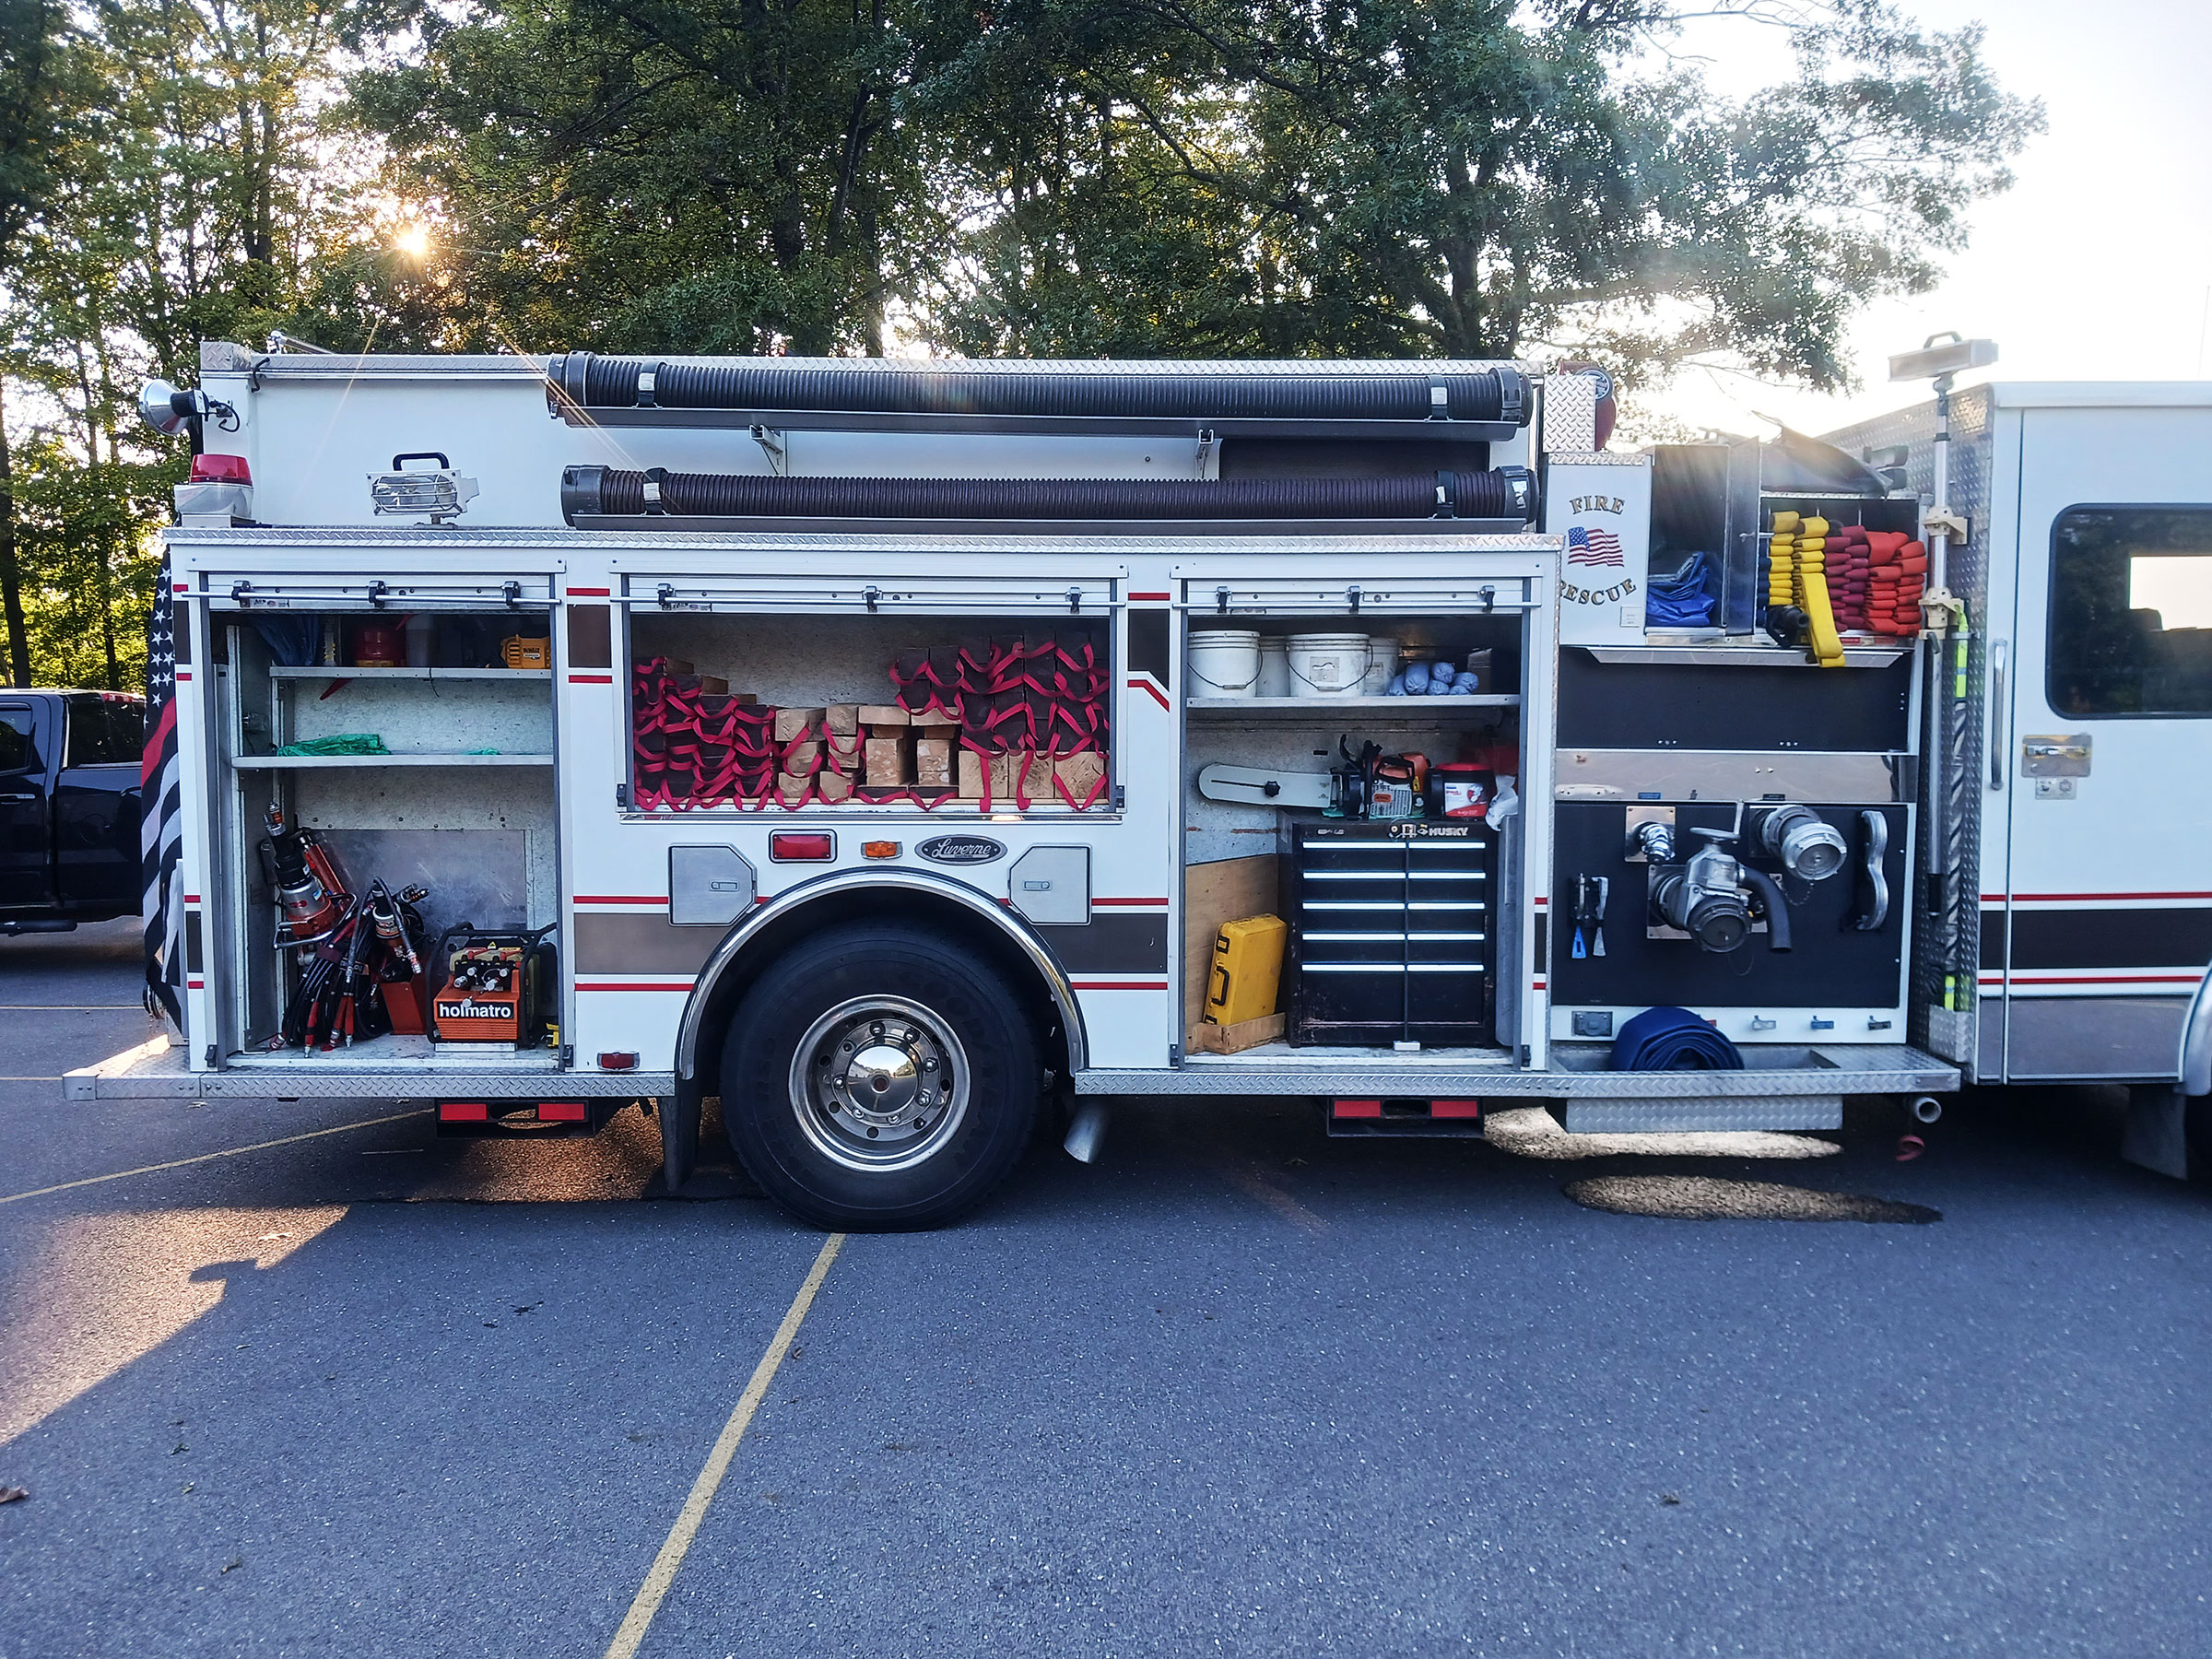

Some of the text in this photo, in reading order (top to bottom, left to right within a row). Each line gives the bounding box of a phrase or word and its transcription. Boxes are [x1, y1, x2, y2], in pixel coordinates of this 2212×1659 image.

[1569, 495, 1626, 515] FIRE
[1429, 827, 1469, 837] HUSKY
[931, 838, 992, 858] Luverne
[439, 1004, 512, 1018] holmatro
